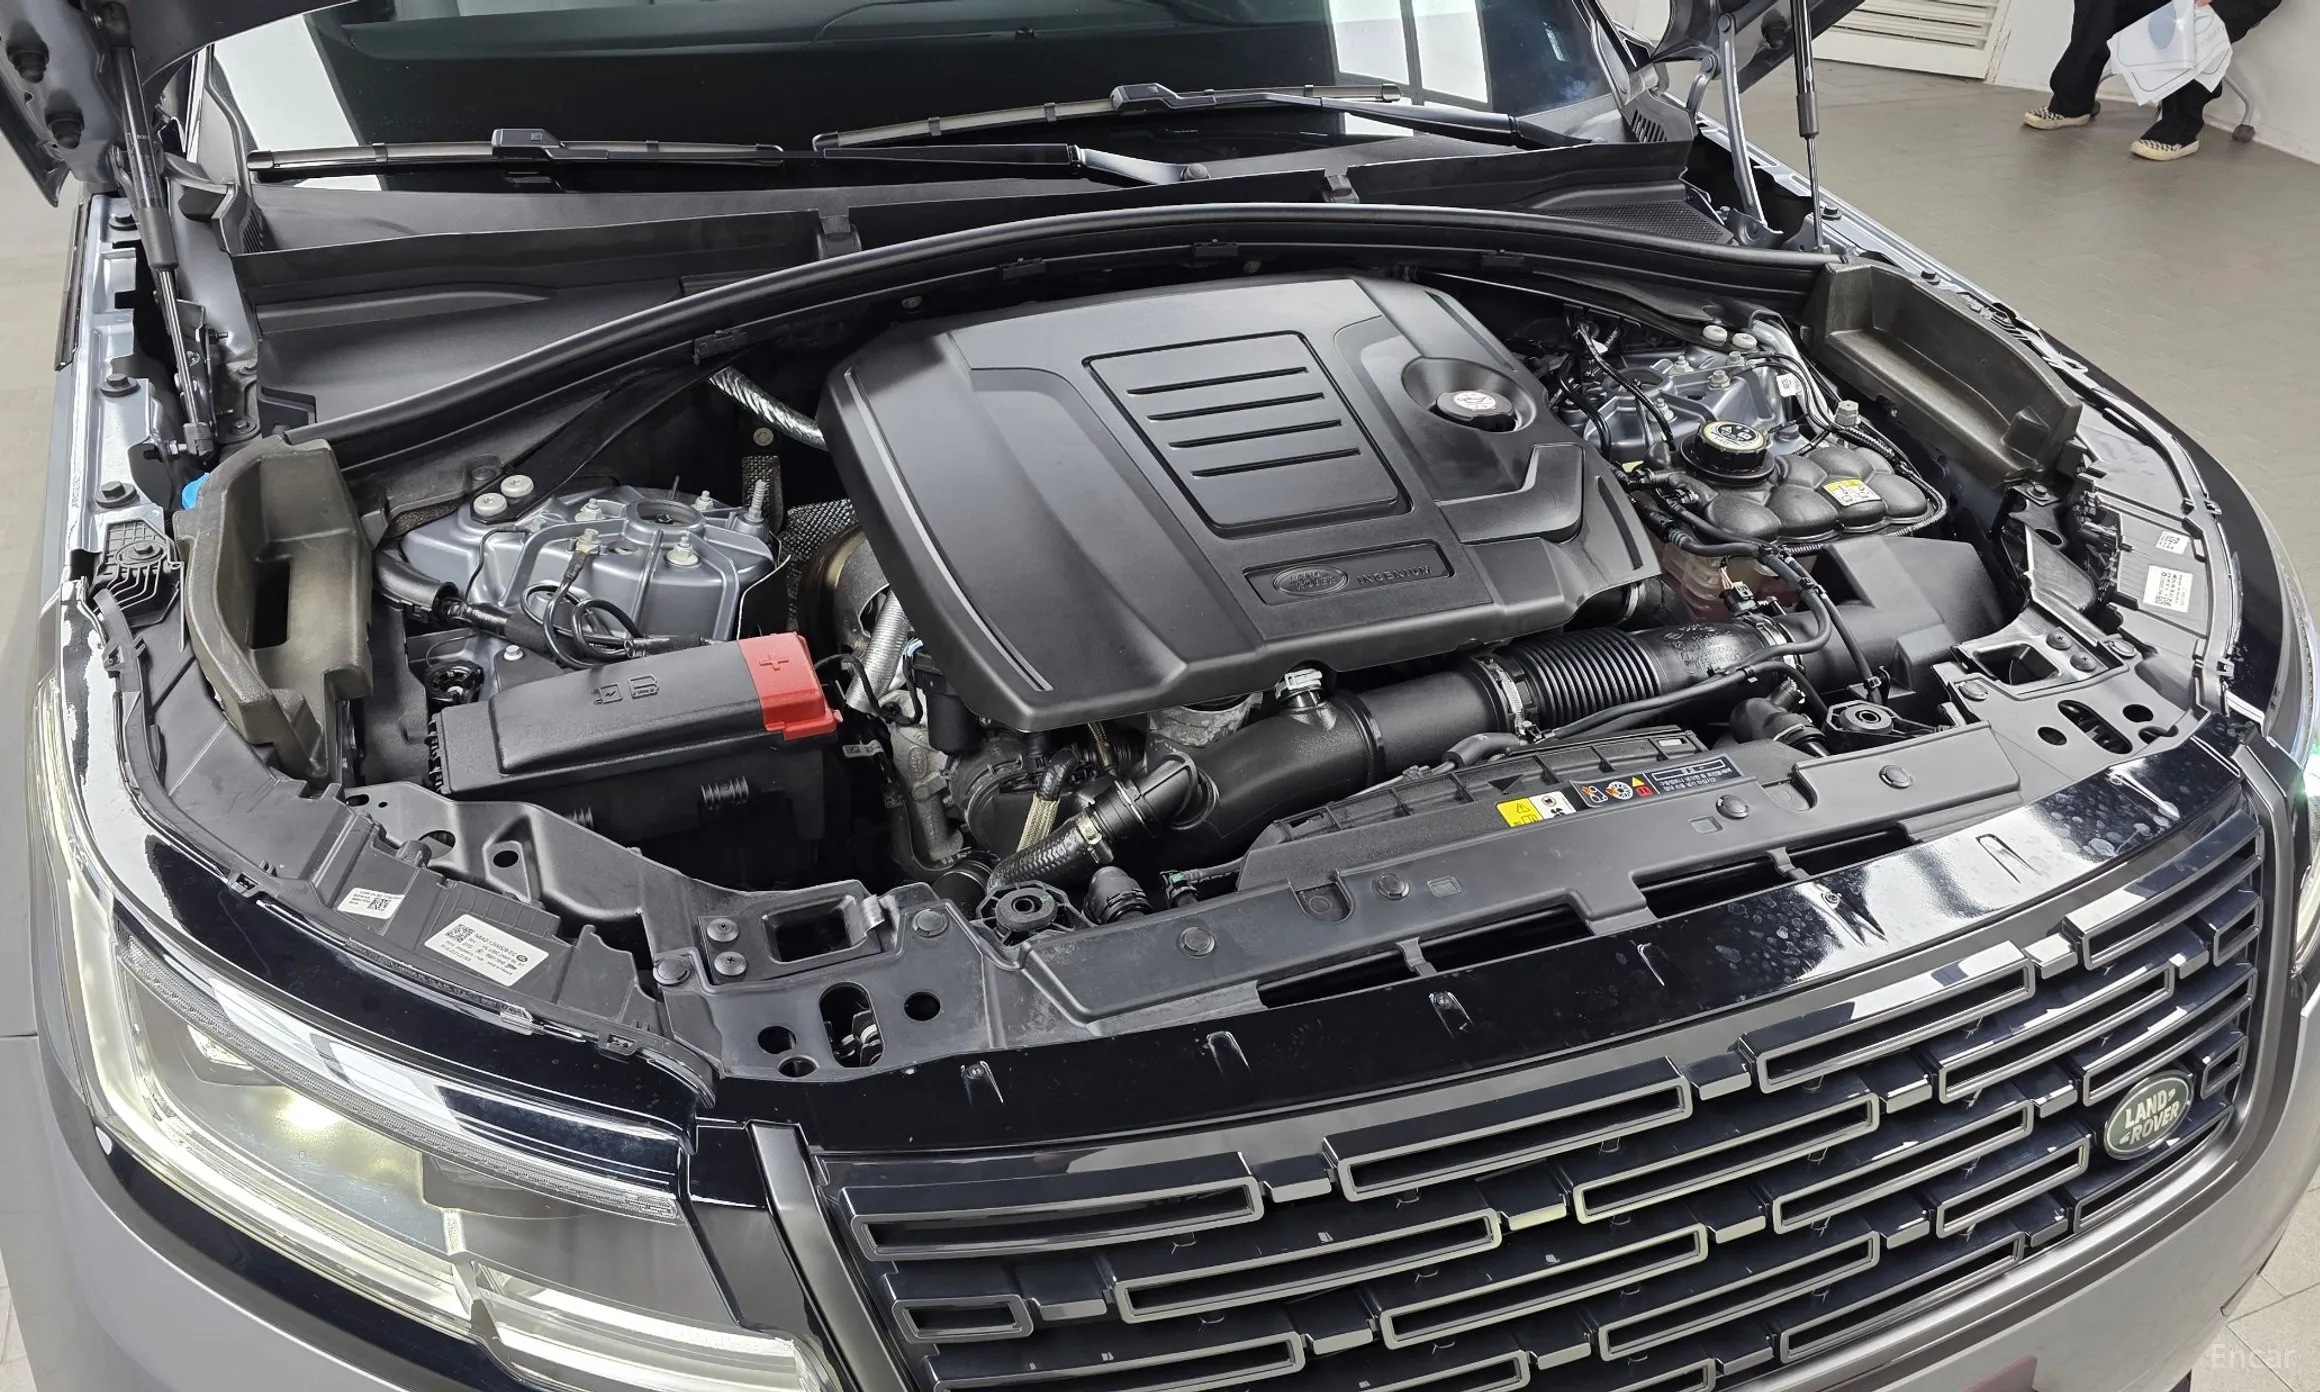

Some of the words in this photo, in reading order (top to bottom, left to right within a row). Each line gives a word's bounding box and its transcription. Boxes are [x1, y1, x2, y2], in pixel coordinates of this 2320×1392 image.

[1356, 565, 1433, 585] INGENIUM
[2124, 1089, 2168, 1129] LAND
[2129, 1100, 2180, 1144] ROVER
